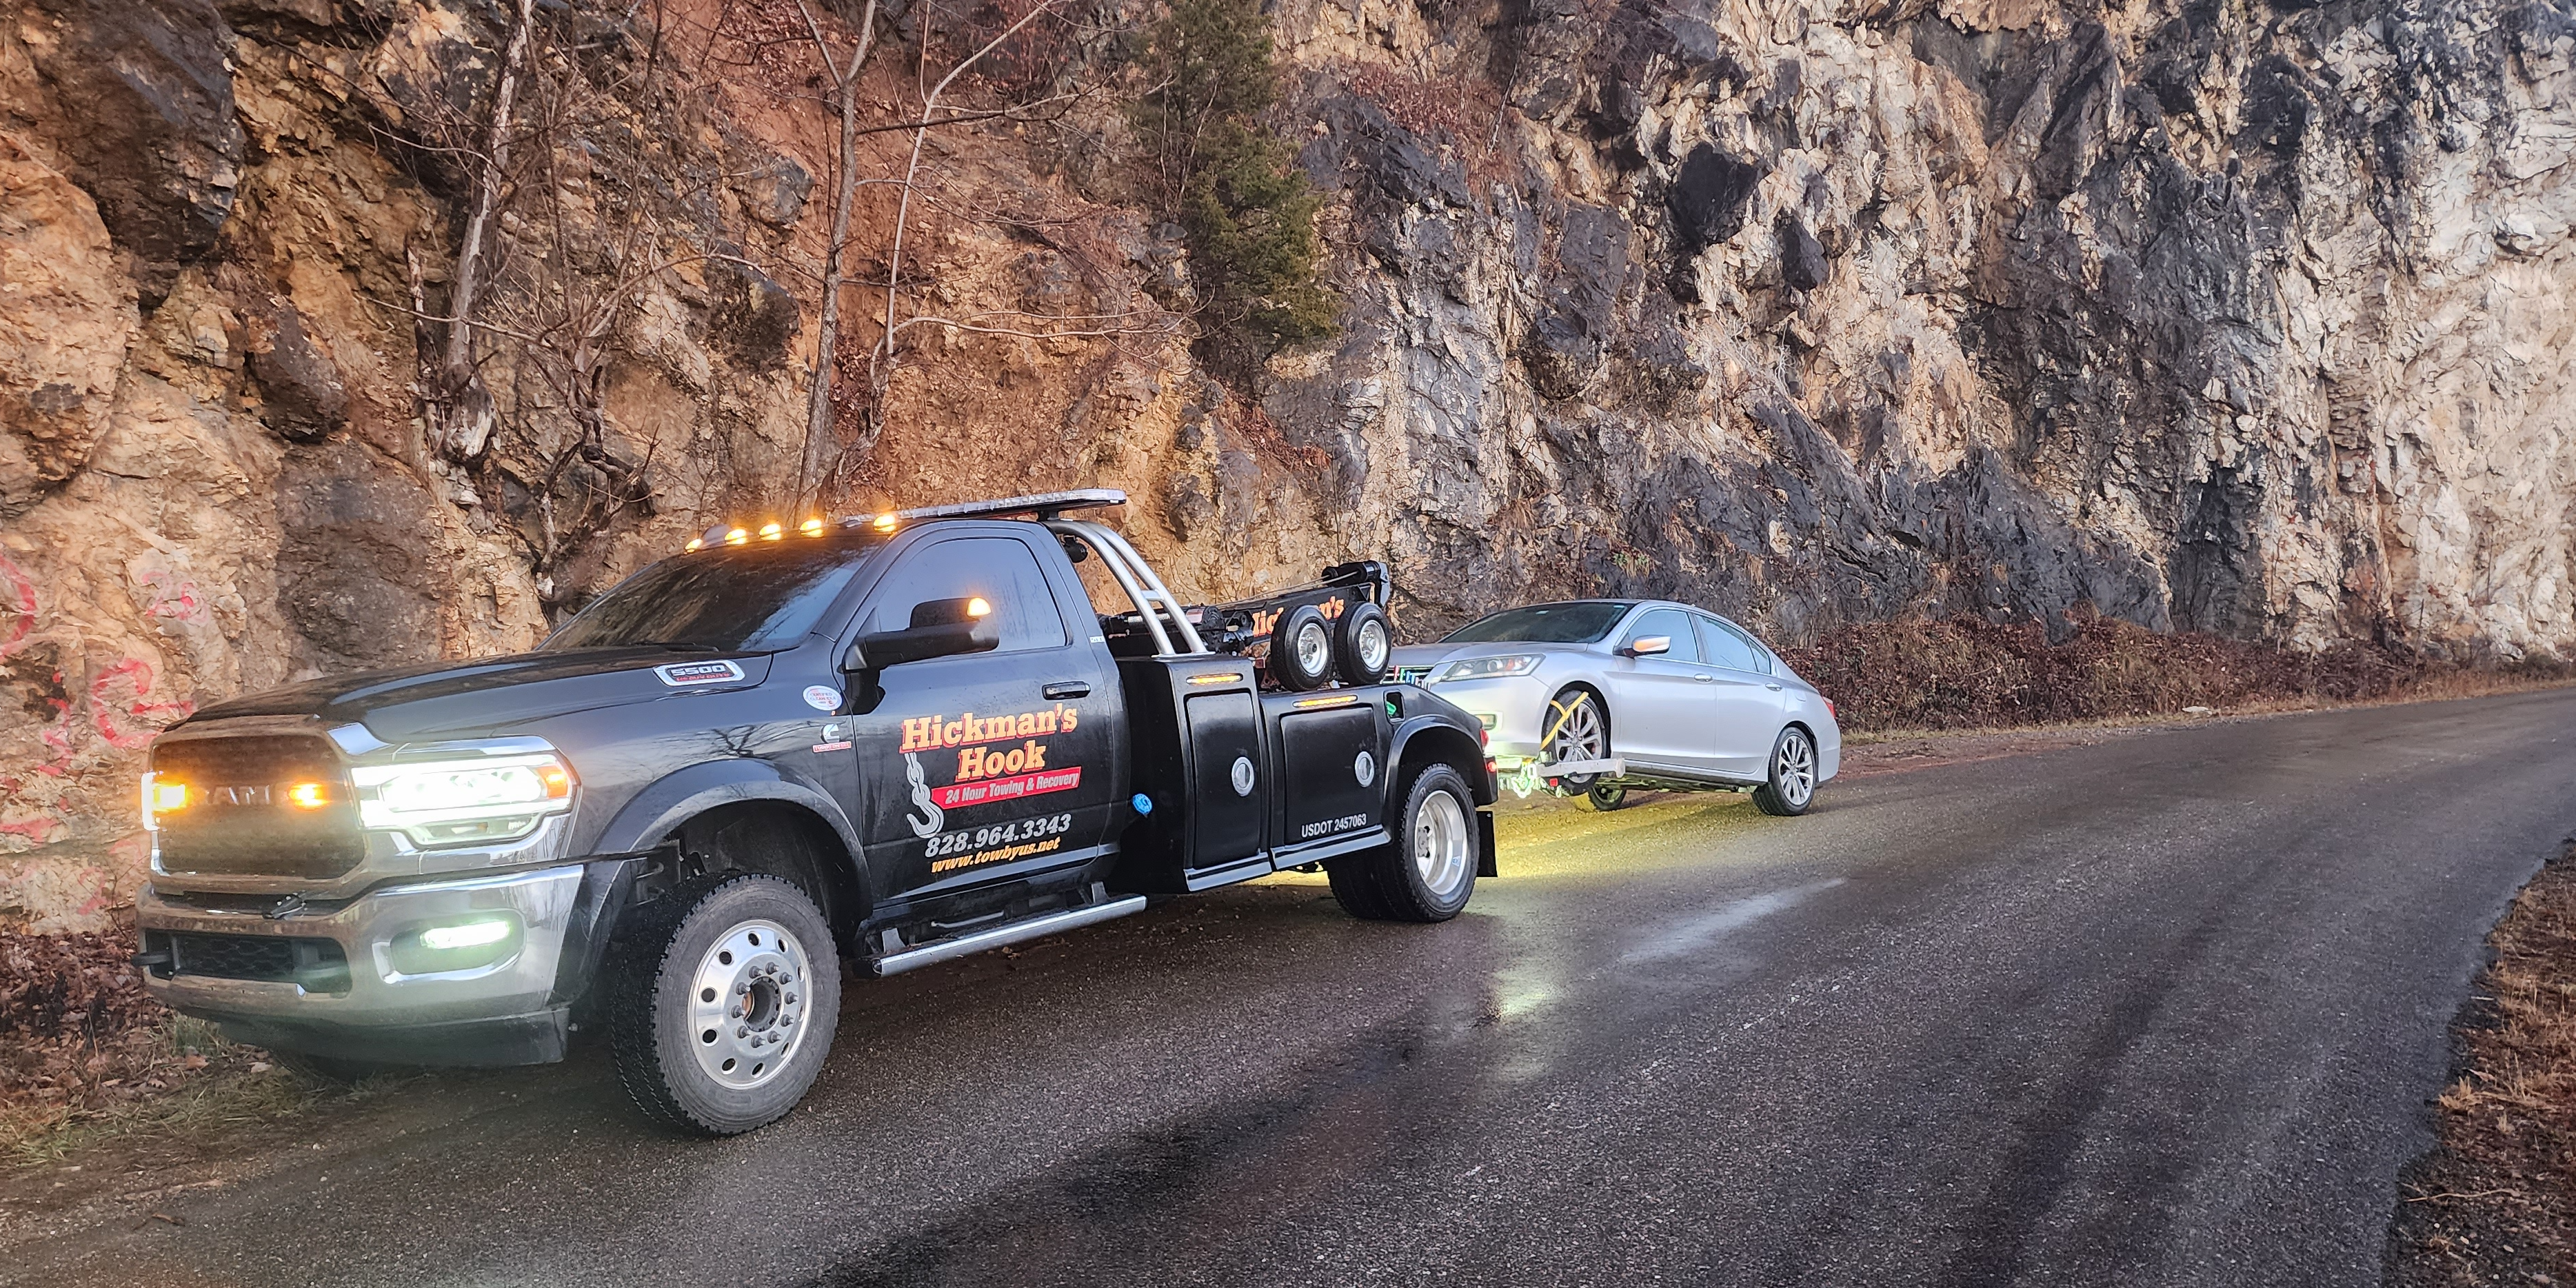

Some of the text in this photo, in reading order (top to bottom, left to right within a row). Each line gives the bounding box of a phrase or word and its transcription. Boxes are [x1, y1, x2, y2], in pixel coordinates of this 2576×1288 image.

[1251, 596, 1345, 638] icn's
[671, 665, 726, 676] 5500
[899, 703, 1078, 754] Hickman's
[955, 739, 1047, 783] Hook
[945, 772, 1080, 805] 24 Hour Towing & Recovery
[925, 813, 1071, 858] 828.964.3343
[1301, 813, 1367, 838] USDOT 2457063
[931, 836, 1060, 873] www.towbyus.net
